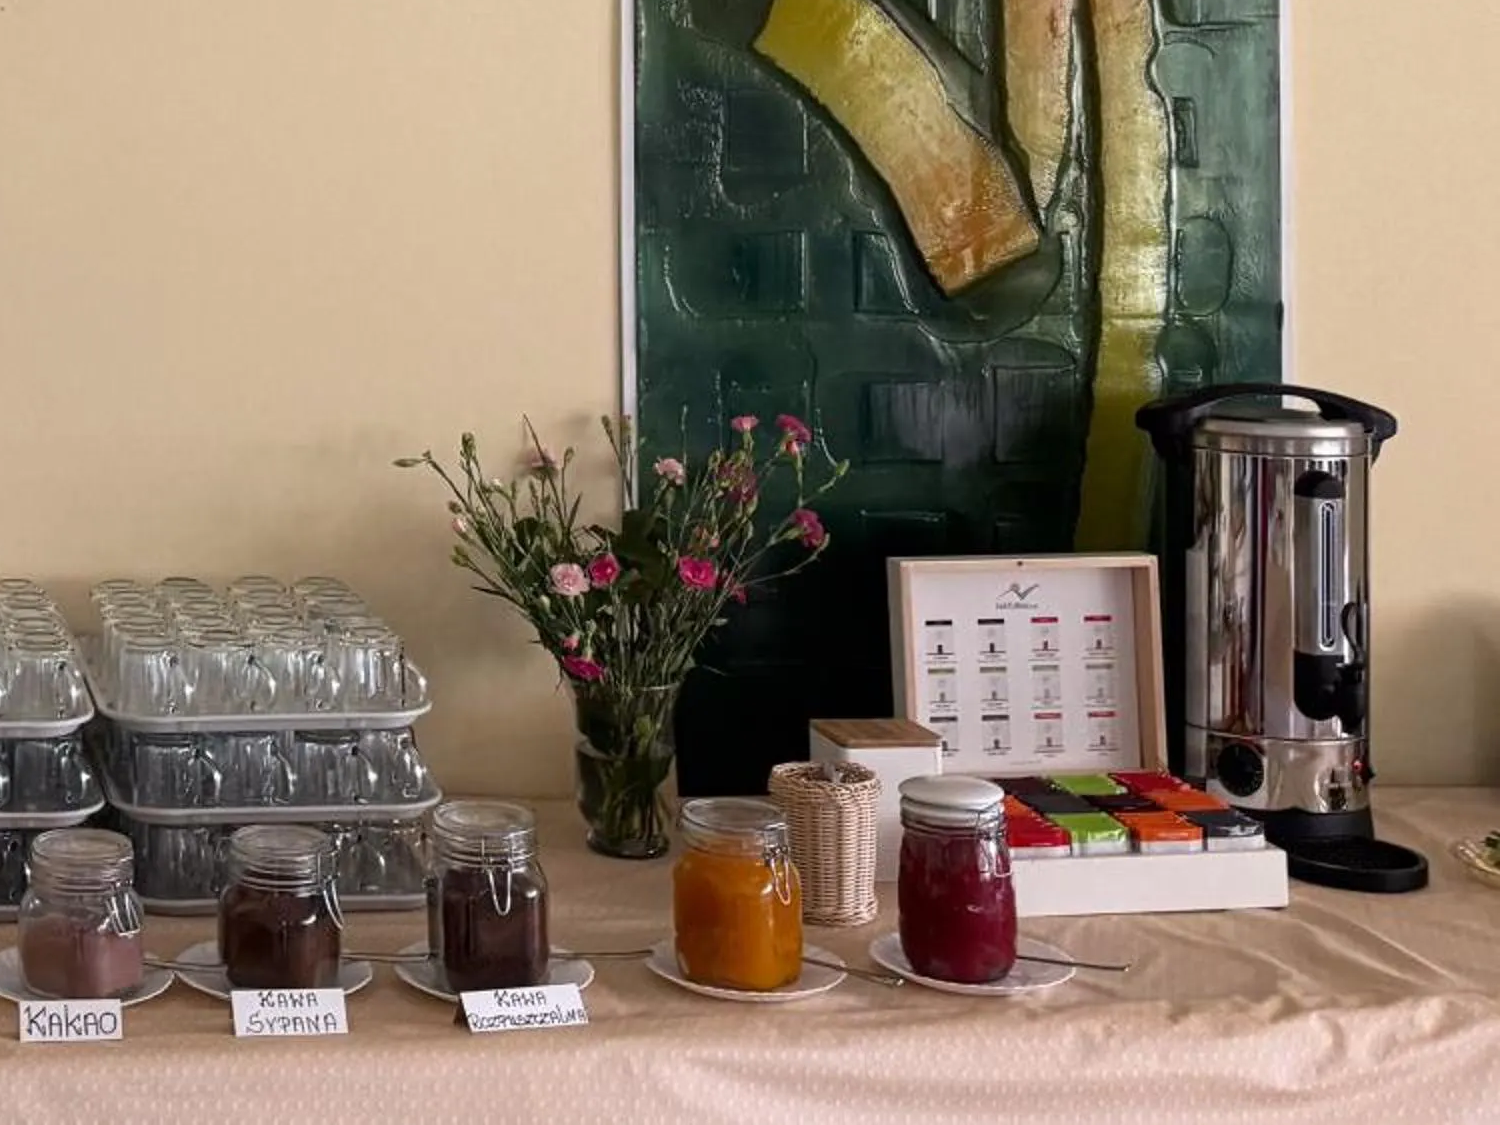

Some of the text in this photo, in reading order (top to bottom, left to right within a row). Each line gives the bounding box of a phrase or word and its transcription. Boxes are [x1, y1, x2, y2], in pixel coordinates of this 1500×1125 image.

[258, 991, 318, 1007] KAWA
[493, 990, 546, 1007] KAWA
[246, 1010, 337, 1033] SYPANA
